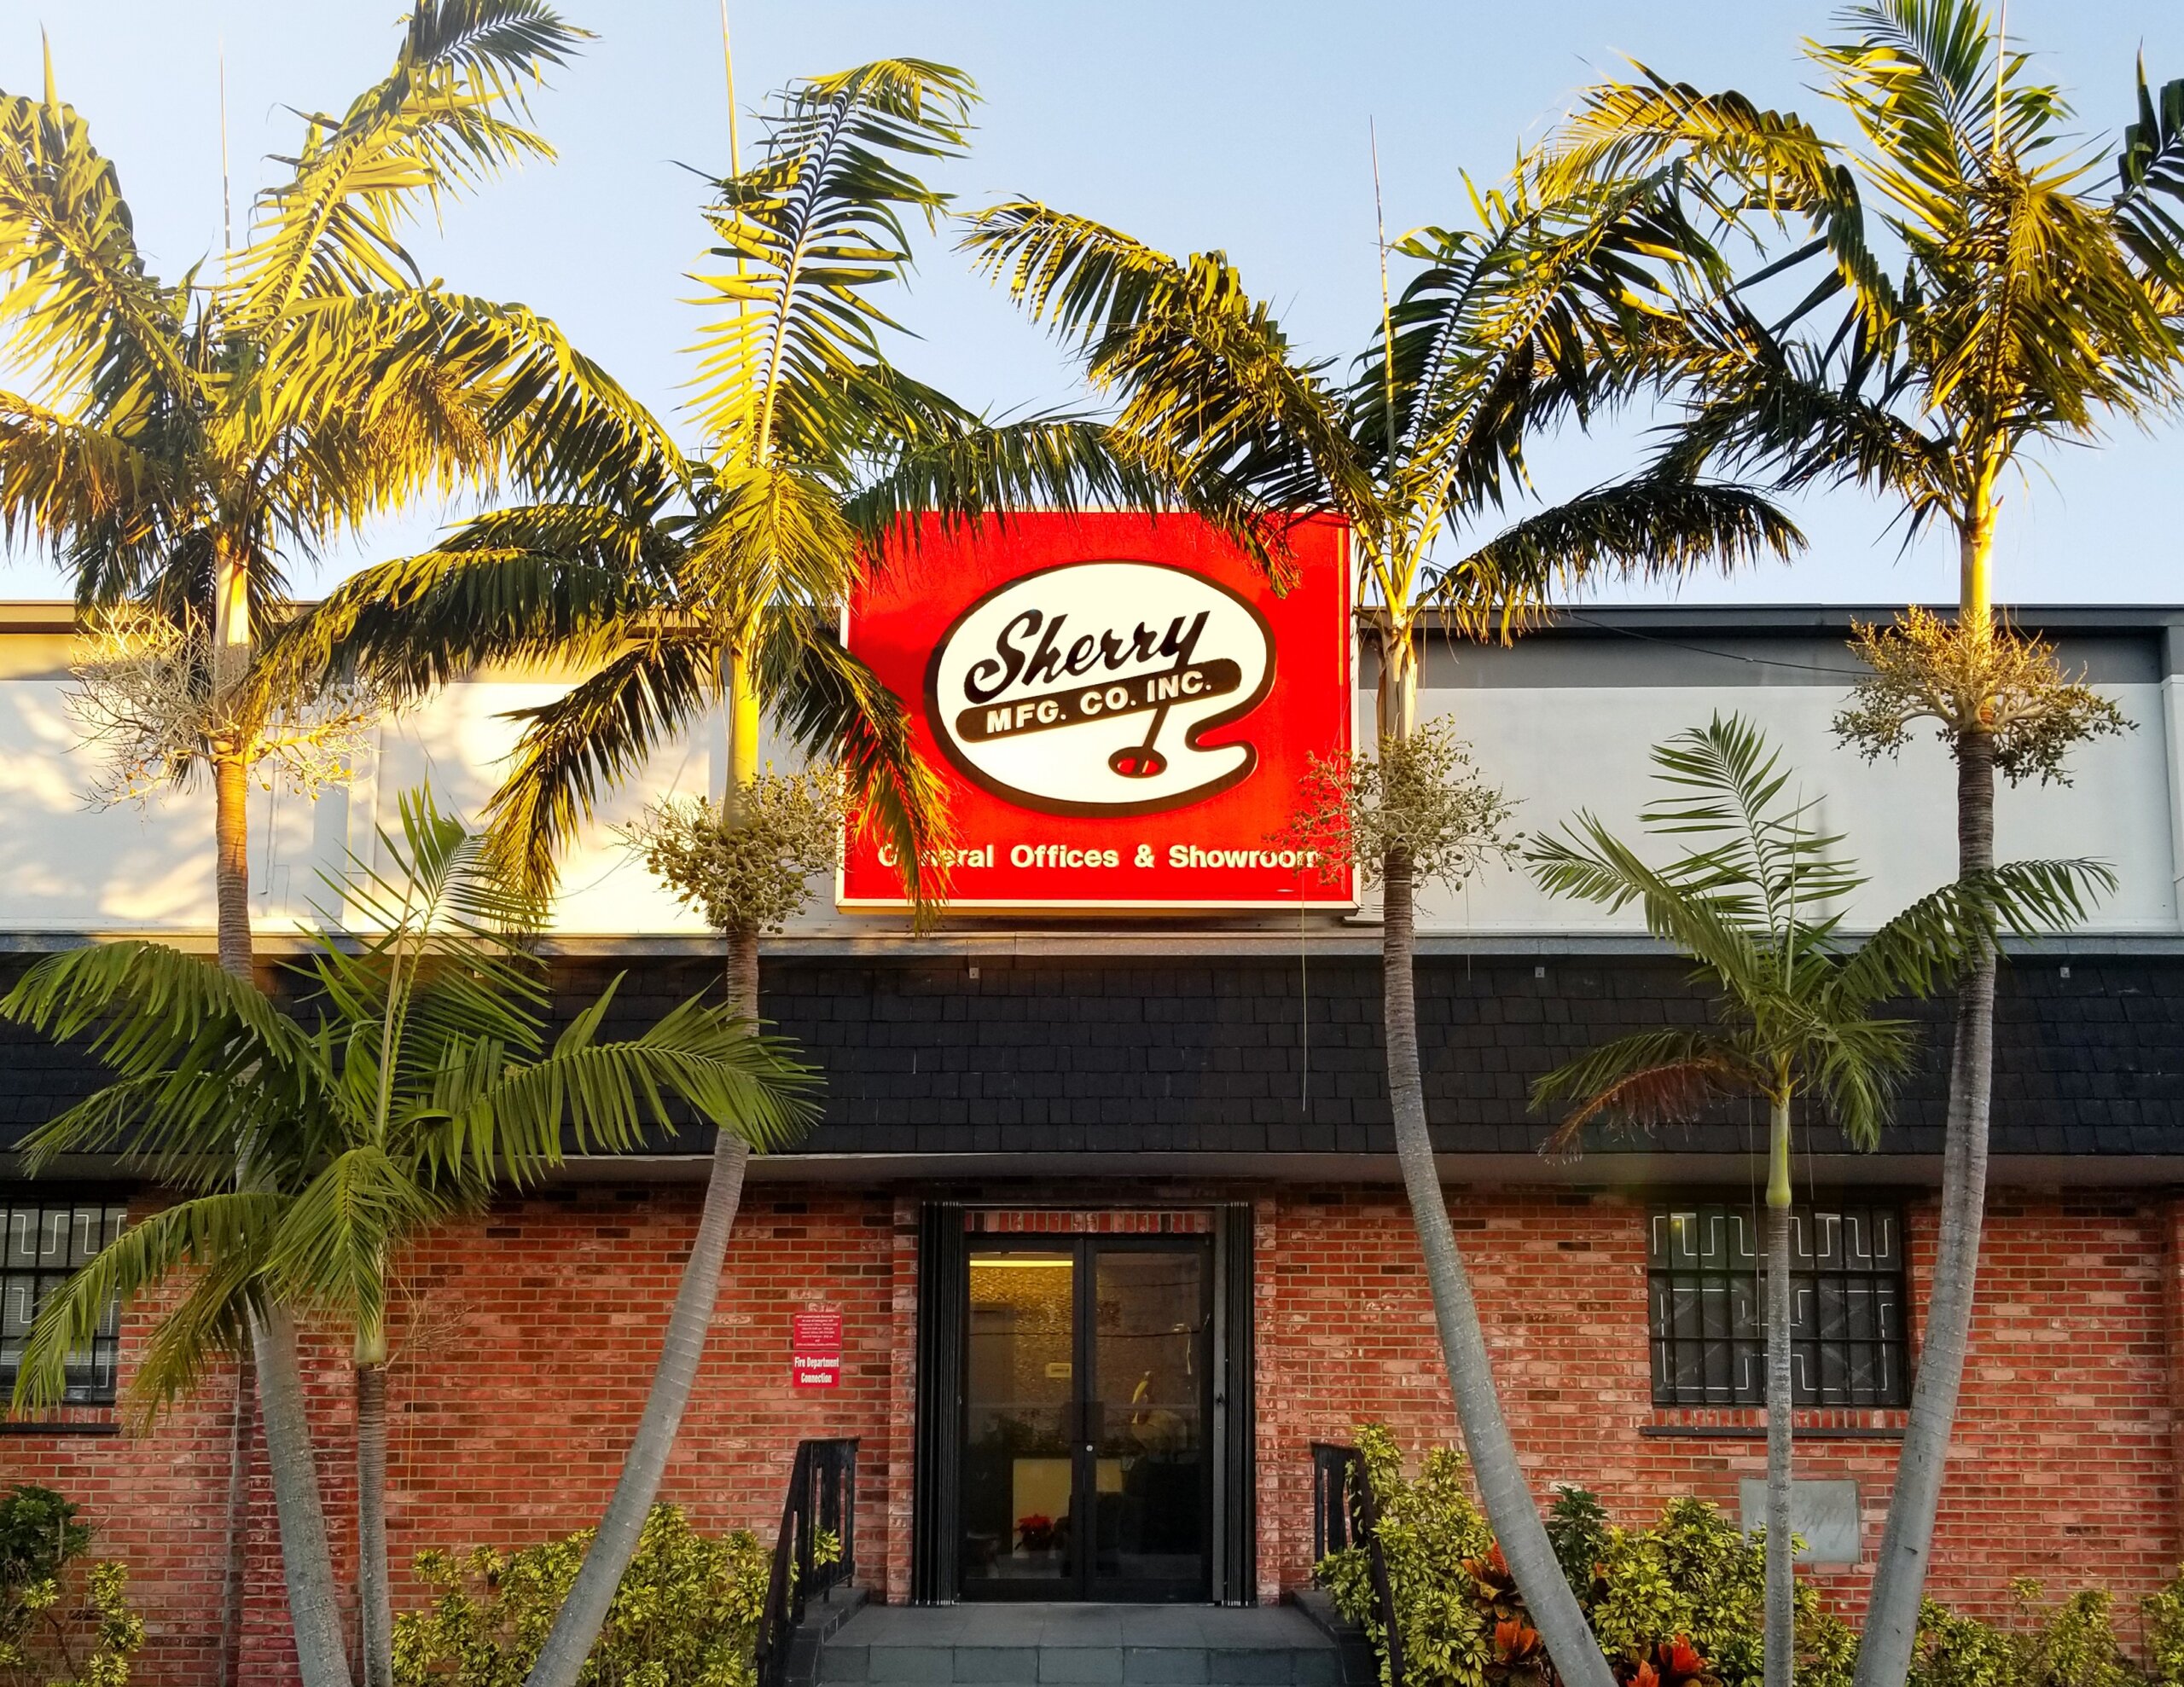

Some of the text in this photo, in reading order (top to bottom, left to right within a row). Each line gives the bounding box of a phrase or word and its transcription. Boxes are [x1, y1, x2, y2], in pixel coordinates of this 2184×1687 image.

[964, 609, 1211, 704] Sherry
[986, 671, 1211, 733] MFG. CO. INC.
[878, 844, 995, 868] Gneral
[1010, 844, 1119, 868] Offices
[1134, 844, 1154, 868] &
[794, 1357, 839, 1370] Fire Department
[801, 1372, 833, 1383] Connection
